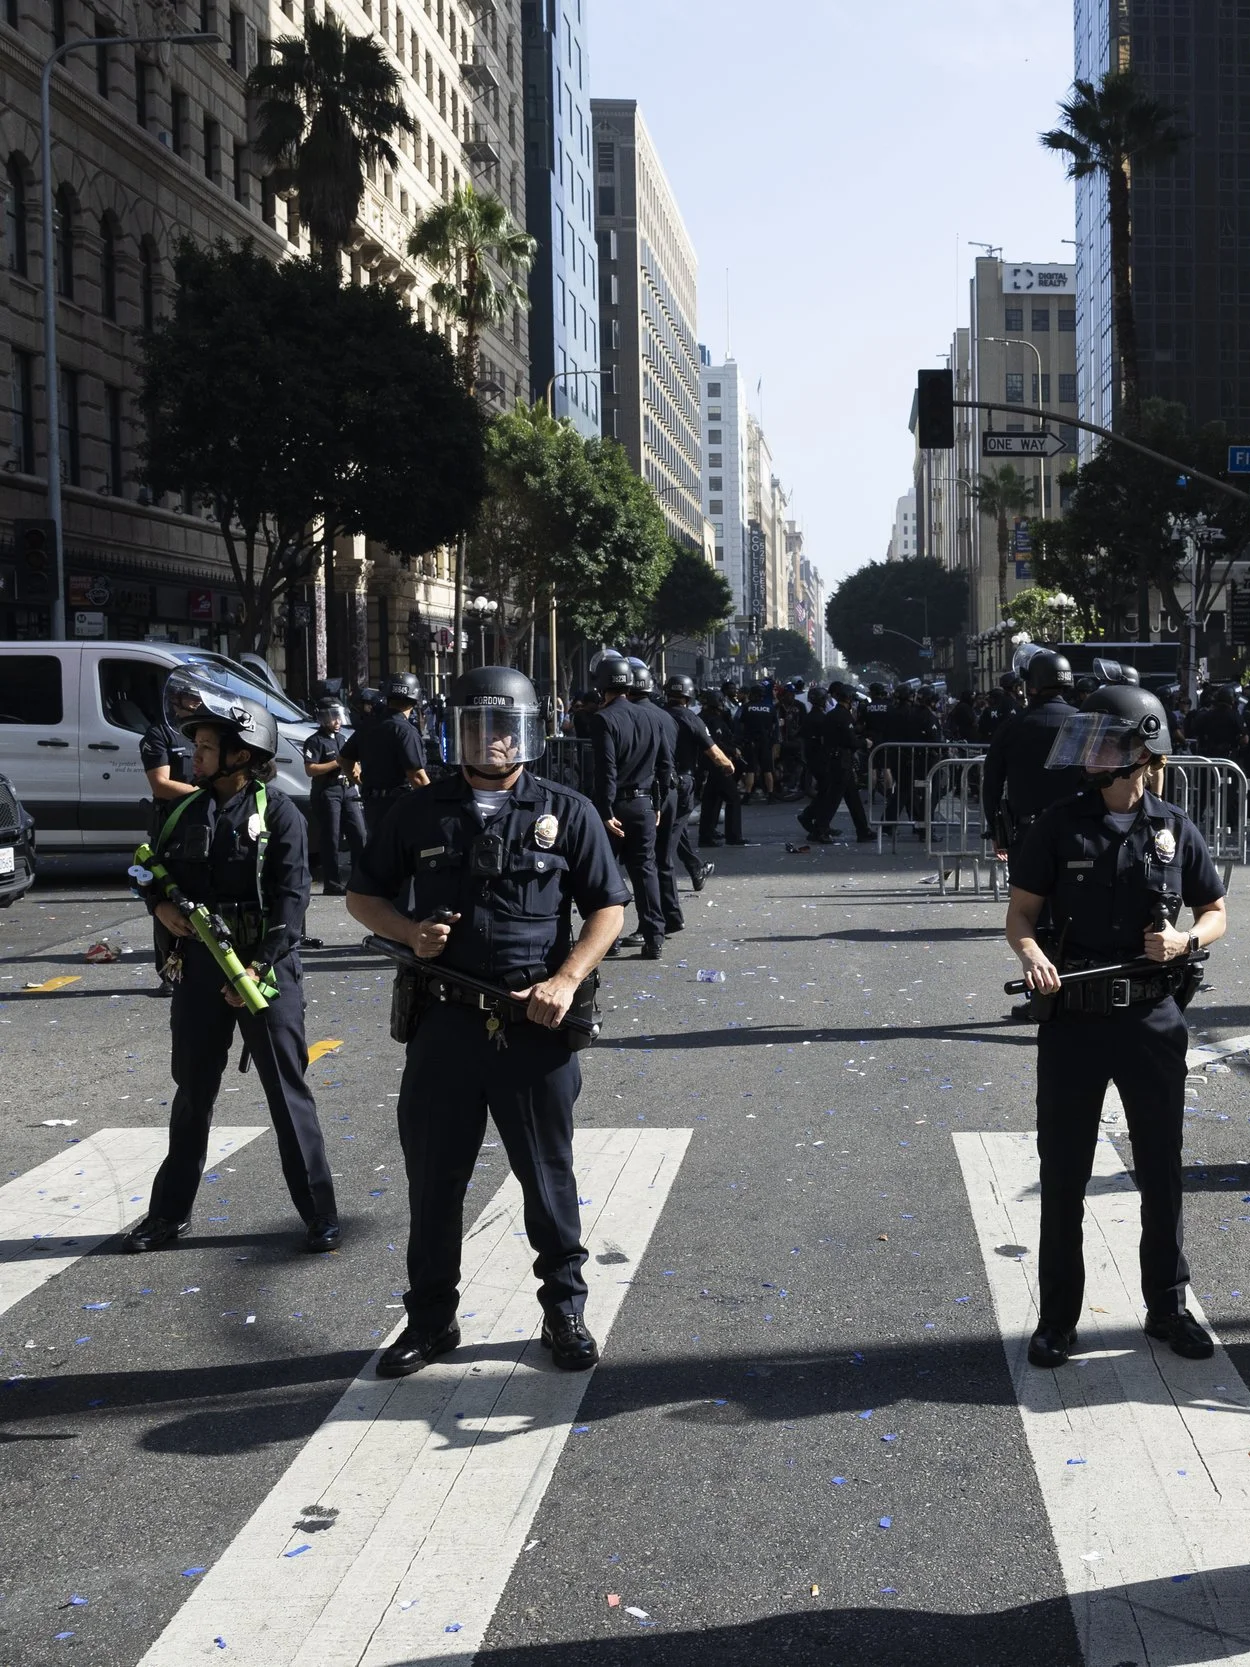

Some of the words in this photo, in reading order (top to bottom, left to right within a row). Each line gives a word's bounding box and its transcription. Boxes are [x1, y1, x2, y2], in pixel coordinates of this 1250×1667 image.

[1038, 272, 1068, 280] DIGITAL
[1038, 279, 1067, 287] REALTY
[988, 438, 1013, 450] ONE
[1020, 438, 1046, 450] WAY
[751, 535, 760, 614] COLLECTION
[473, 695, 506, 706] CORDOVA
